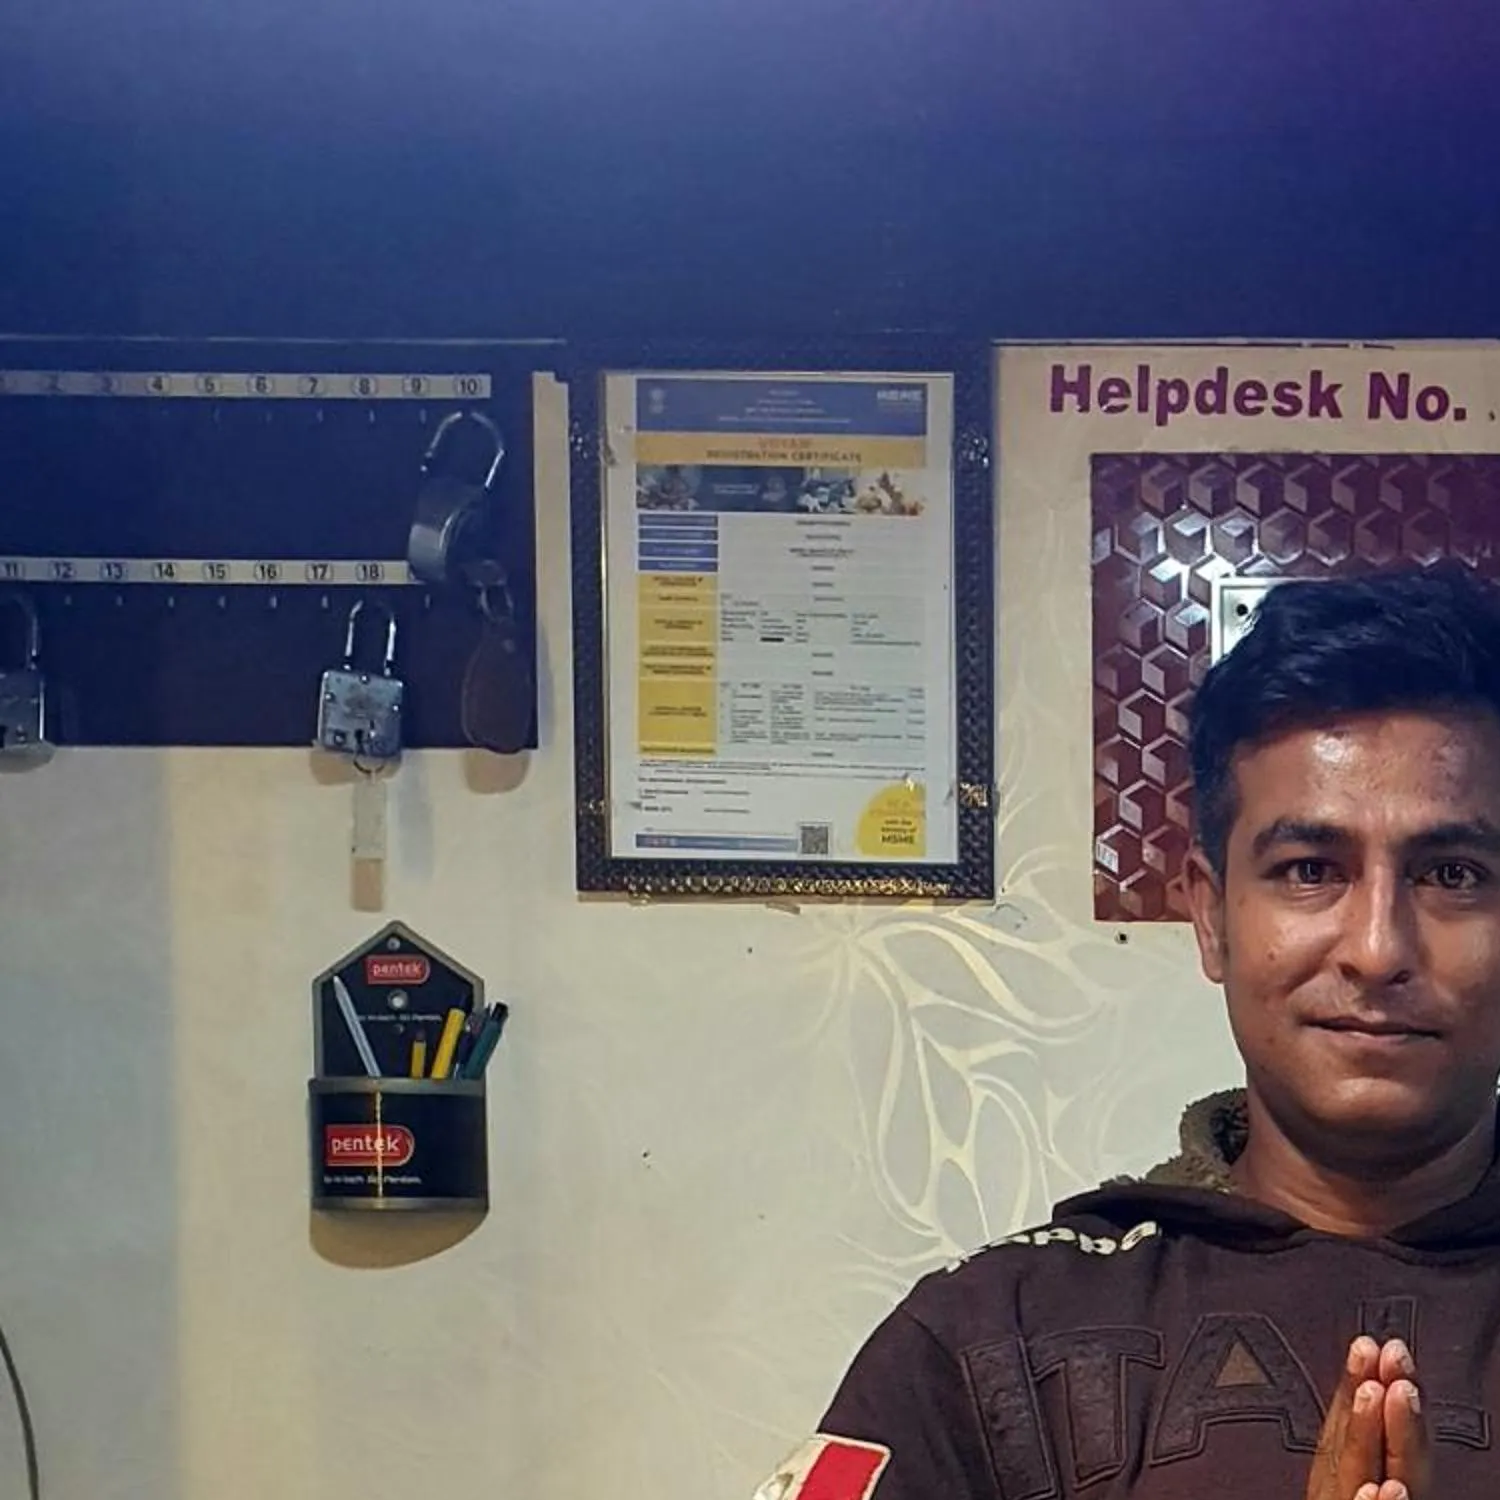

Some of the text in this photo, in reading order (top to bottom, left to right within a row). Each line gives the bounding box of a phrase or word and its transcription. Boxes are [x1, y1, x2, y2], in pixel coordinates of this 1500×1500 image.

[152, 376, 163, 391] 4
[204, 376, 216, 393] 5
[255, 377, 268, 393] 6
[308, 377, 319, 394] 7
[359, 378, 371, 394] 8
[411, 378, 422, 394] 9
[460, 379, 478, 395] 10
[1049, 365, 1468, 427] Helpdesk No.
[4, 562, 19, 577] 11
[53, 562, 74, 578] 12
[105, 563, 123, 579] 13
[156, 563, 175, 578] 14
[207, 563, 226, 579] 15
[259, 563, 277, 579] 16
[311, 563, 329, 579] 17
[362, 564, 380, 580] 18
[372, 961, 421, 977] pentek
[331, 1134, 401, 1154] pentek
